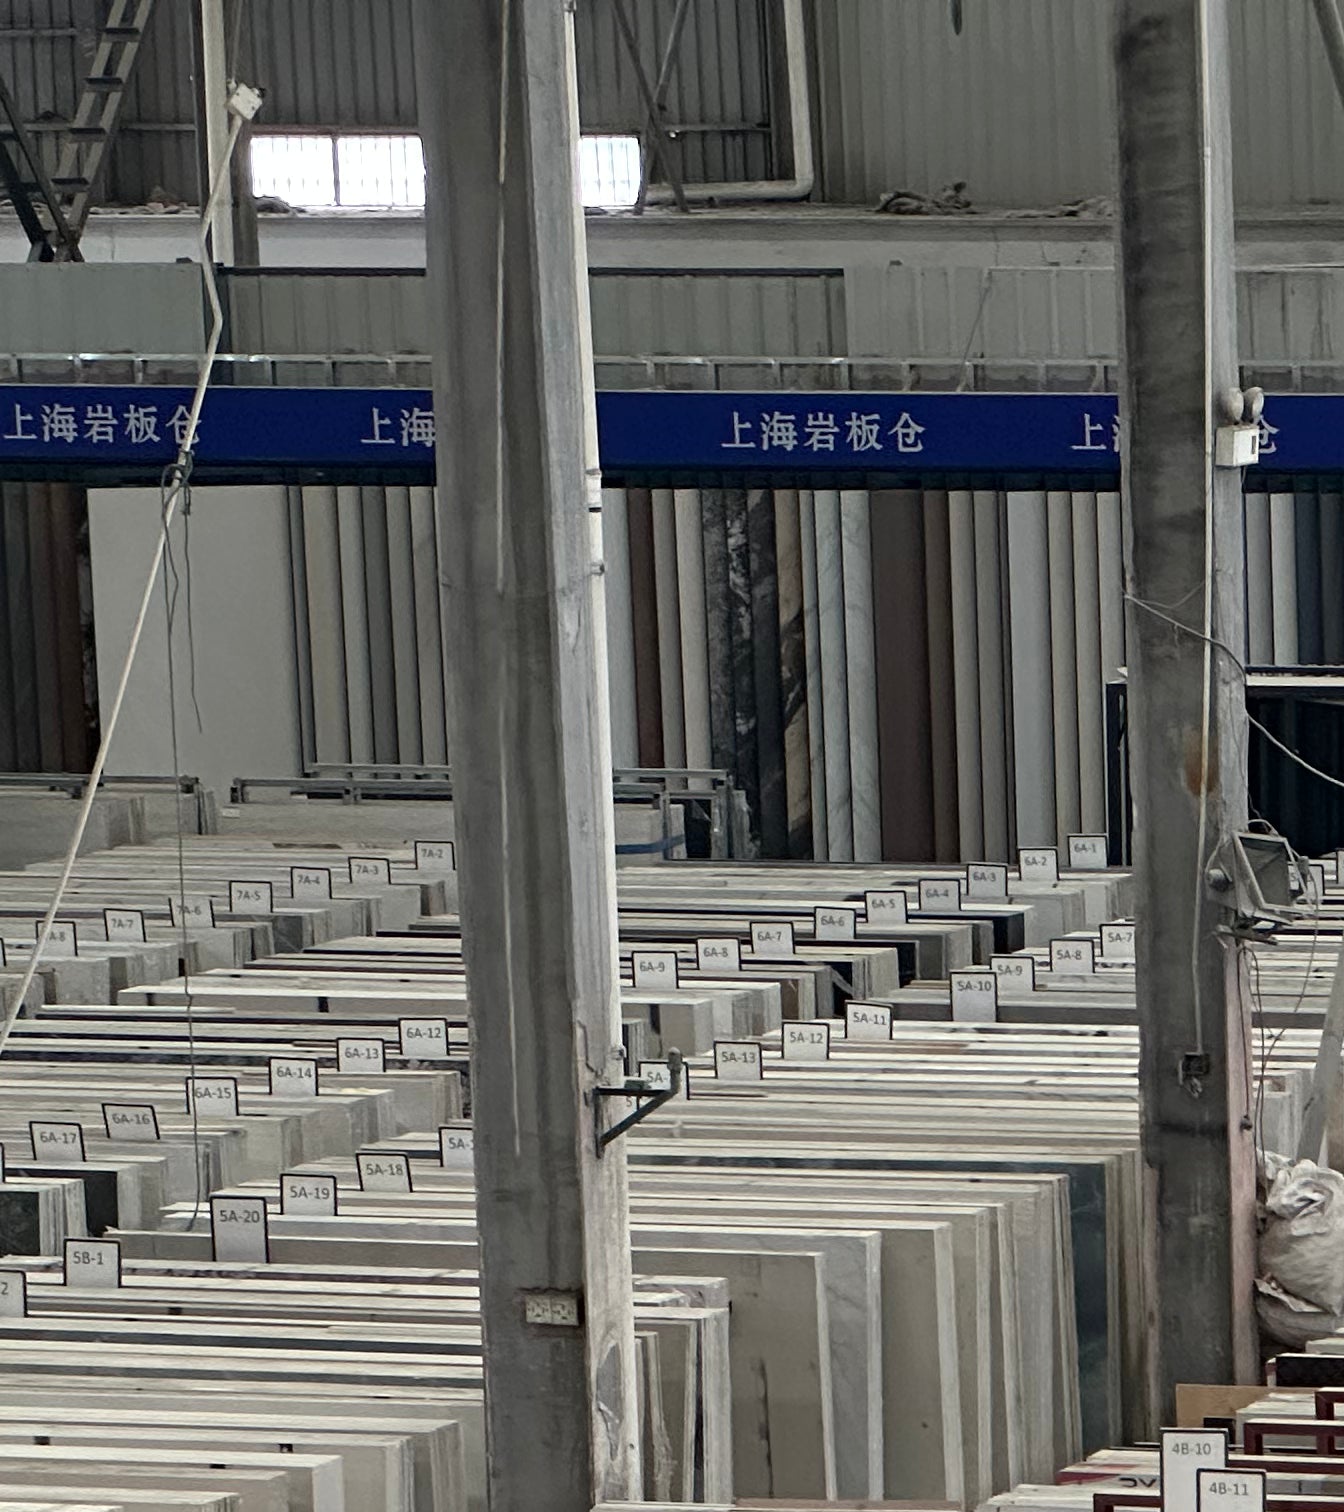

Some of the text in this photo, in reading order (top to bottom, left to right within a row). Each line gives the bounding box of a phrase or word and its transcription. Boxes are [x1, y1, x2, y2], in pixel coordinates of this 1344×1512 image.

[3, 403, 203, 444] 上海岩板仓
[721, 412, 925, 452] 上海岩板仓
[853, 1012, 886, 1025] 5A-11
[790, 1032, 822, 1044] 5A-12
[277, 1066, 312, 1078] 6A-14
[195, 1087, 232, 1099] 6A-15
[40, 1132, 76, 1144] 6A-17
[290, 1186, 329, 1199] 5A-19
[220, 1210, 260, 1223] 5A-20
[74, 1251, 103, 1265] 5B-1
[1172, 1443, 1211, 1455] 4B-10
[1209, 1482, 1248, 1496] 4B-11
